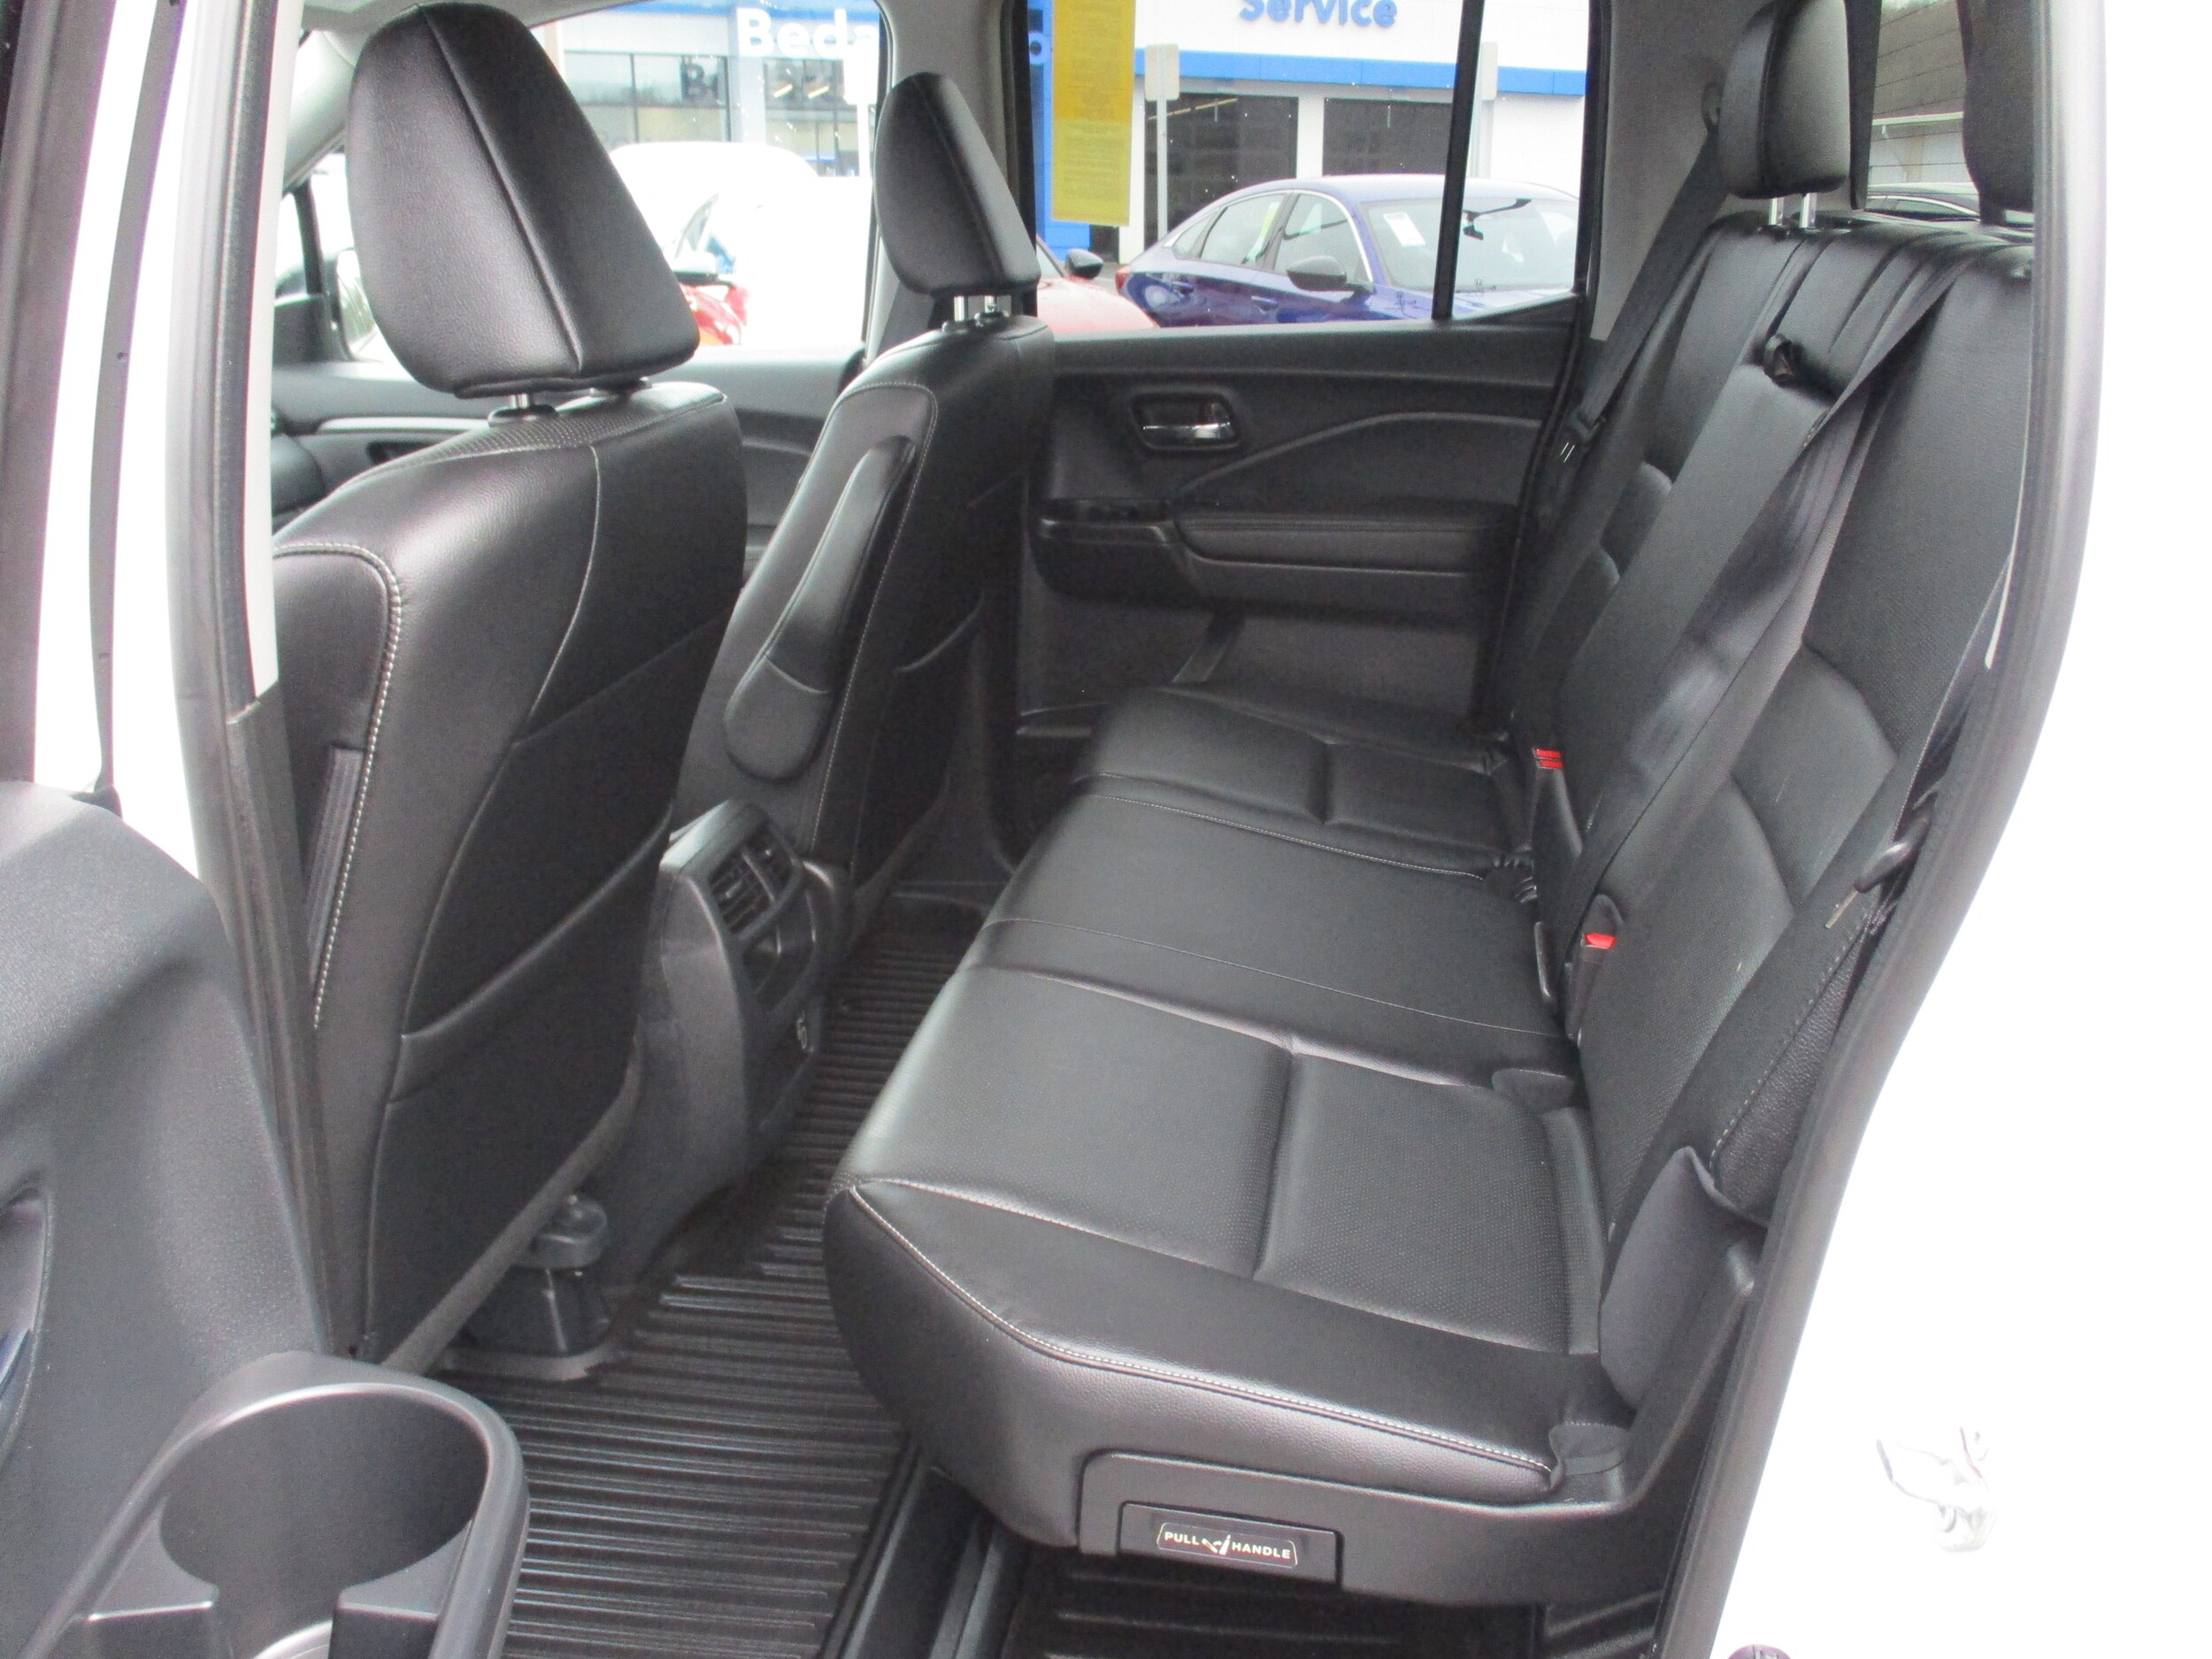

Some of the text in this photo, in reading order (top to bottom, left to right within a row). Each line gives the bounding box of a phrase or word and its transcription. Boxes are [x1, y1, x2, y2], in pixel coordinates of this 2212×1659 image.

[1240, 0, 1398, 28] Service
[1164, 1531, 1291, 1560] PULL HANDLE
